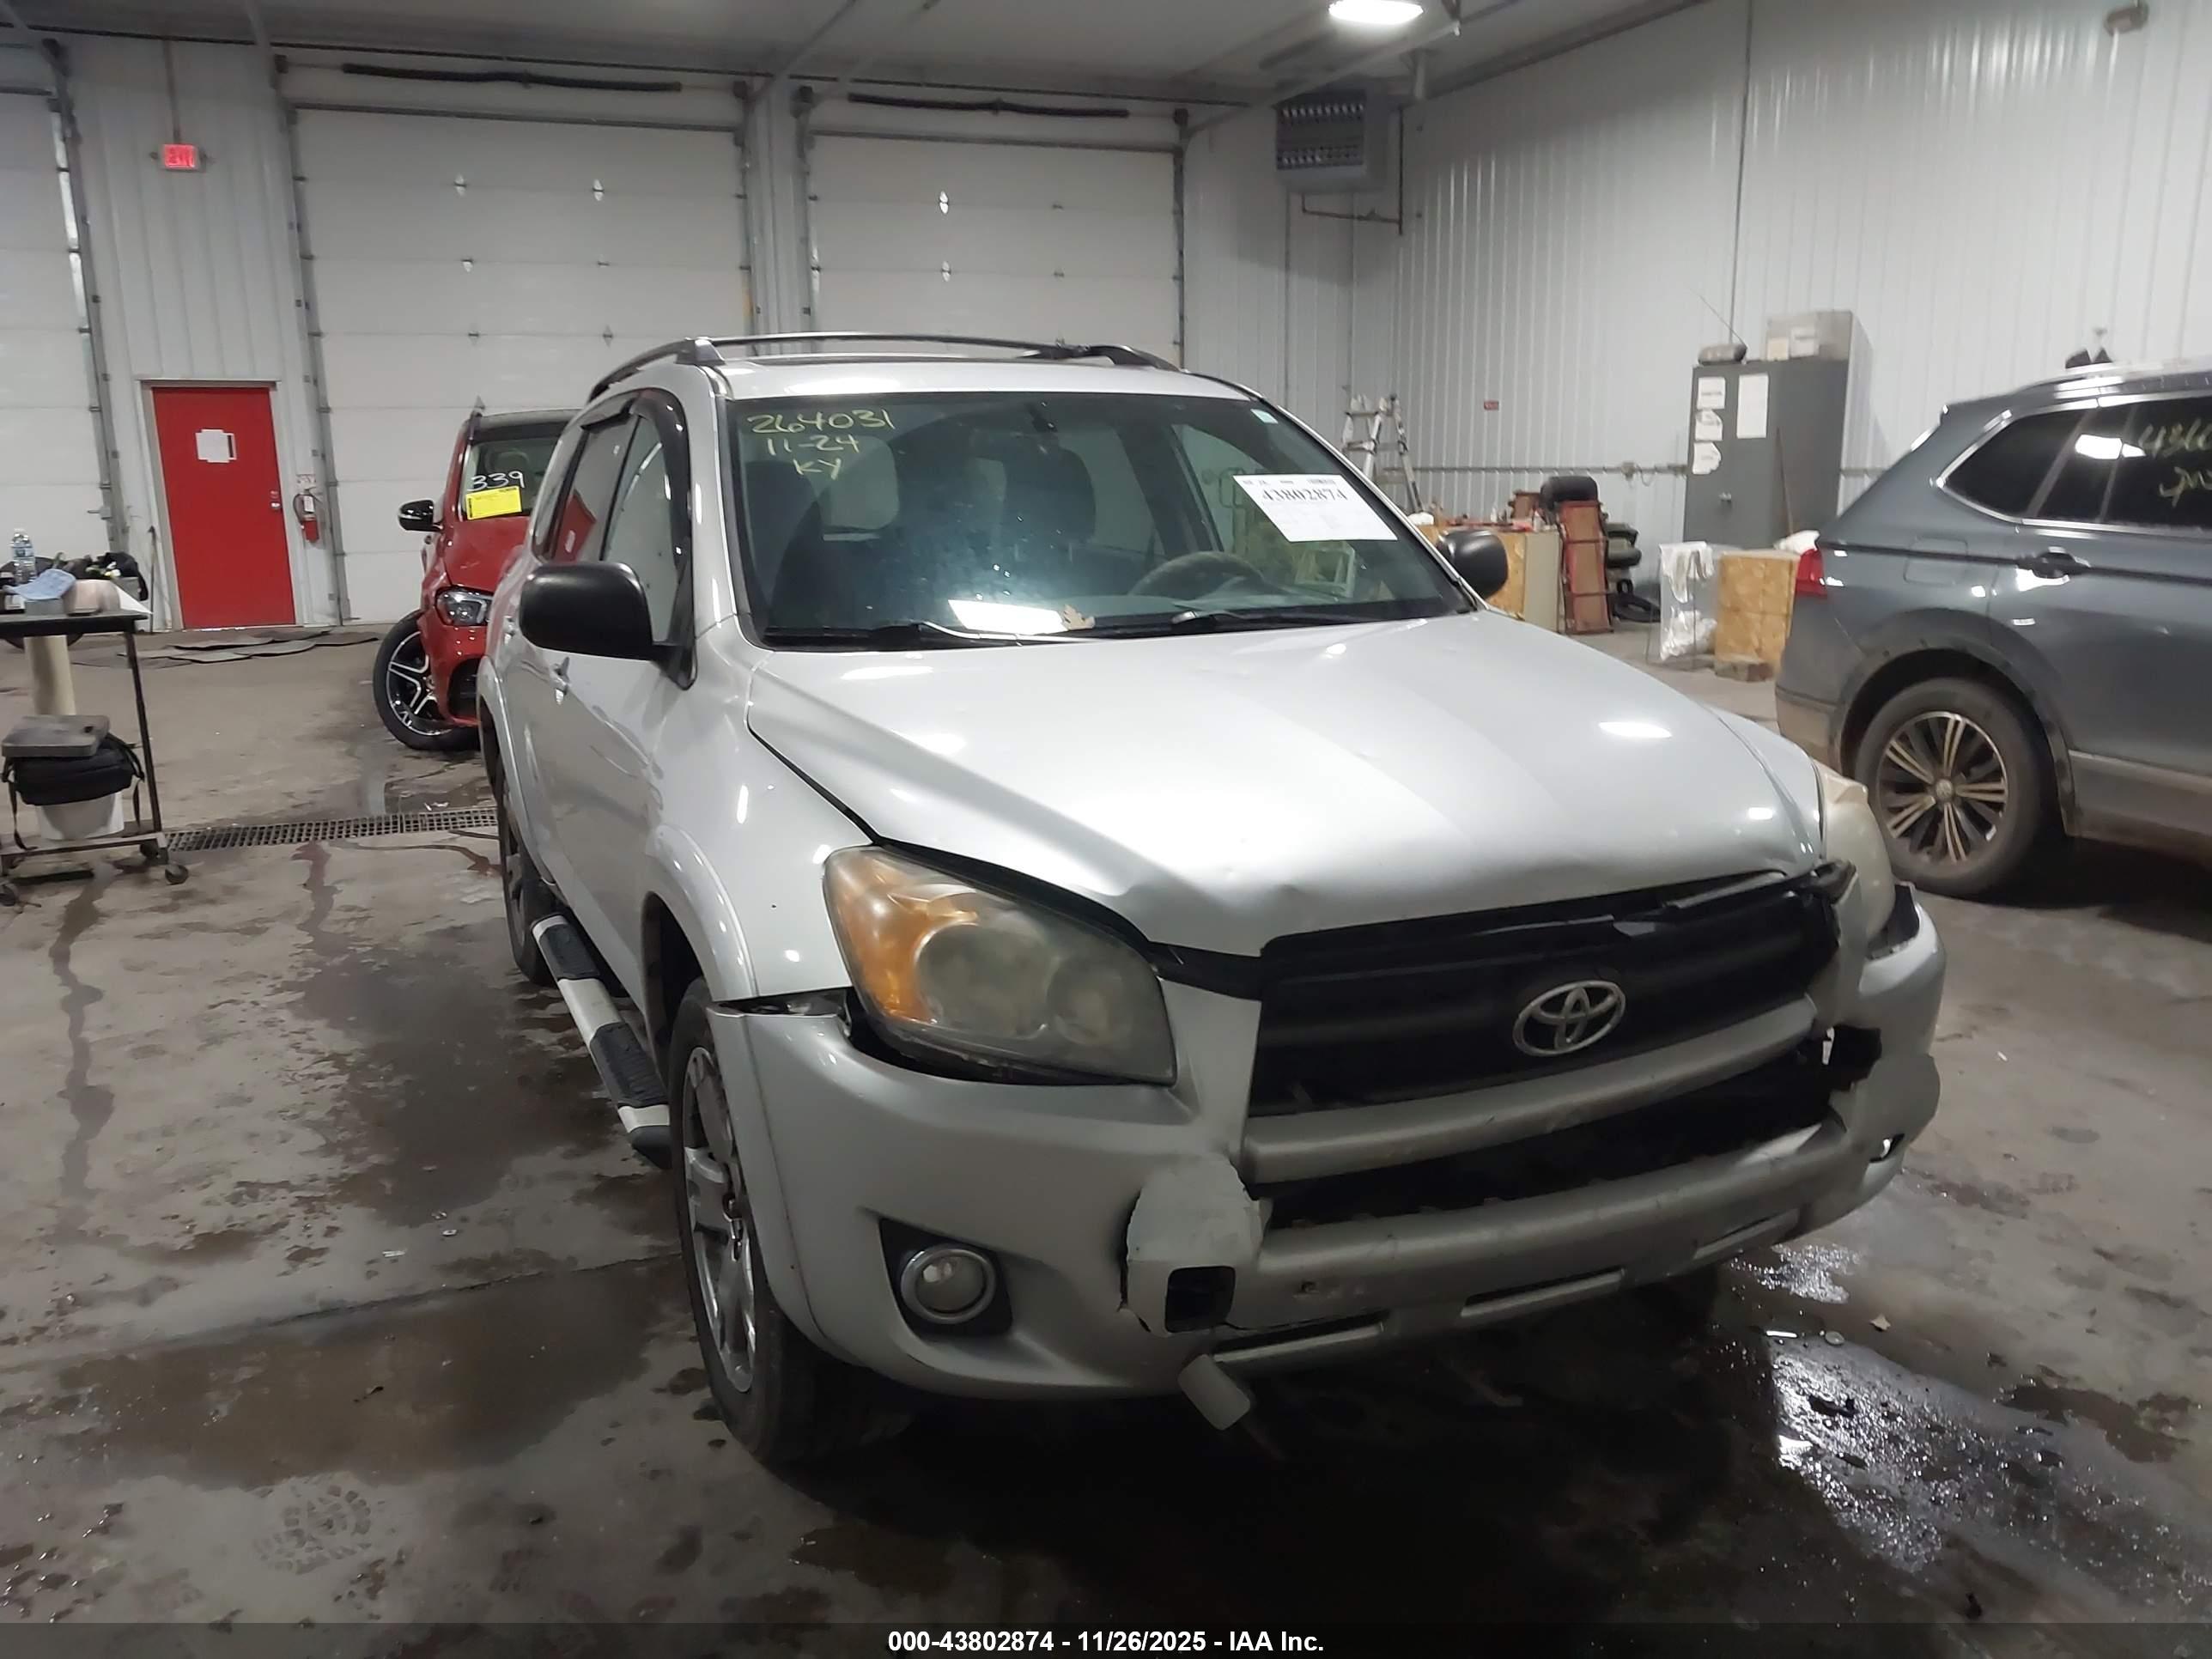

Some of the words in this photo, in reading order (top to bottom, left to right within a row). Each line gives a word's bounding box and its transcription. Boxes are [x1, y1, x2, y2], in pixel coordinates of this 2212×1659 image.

[746, 409, 896, 434] 264031
[766, 434, 860, 456] 11-24
[466, 470, 526, 492] 339
[1262, 489, 1349, 501] 43802874
